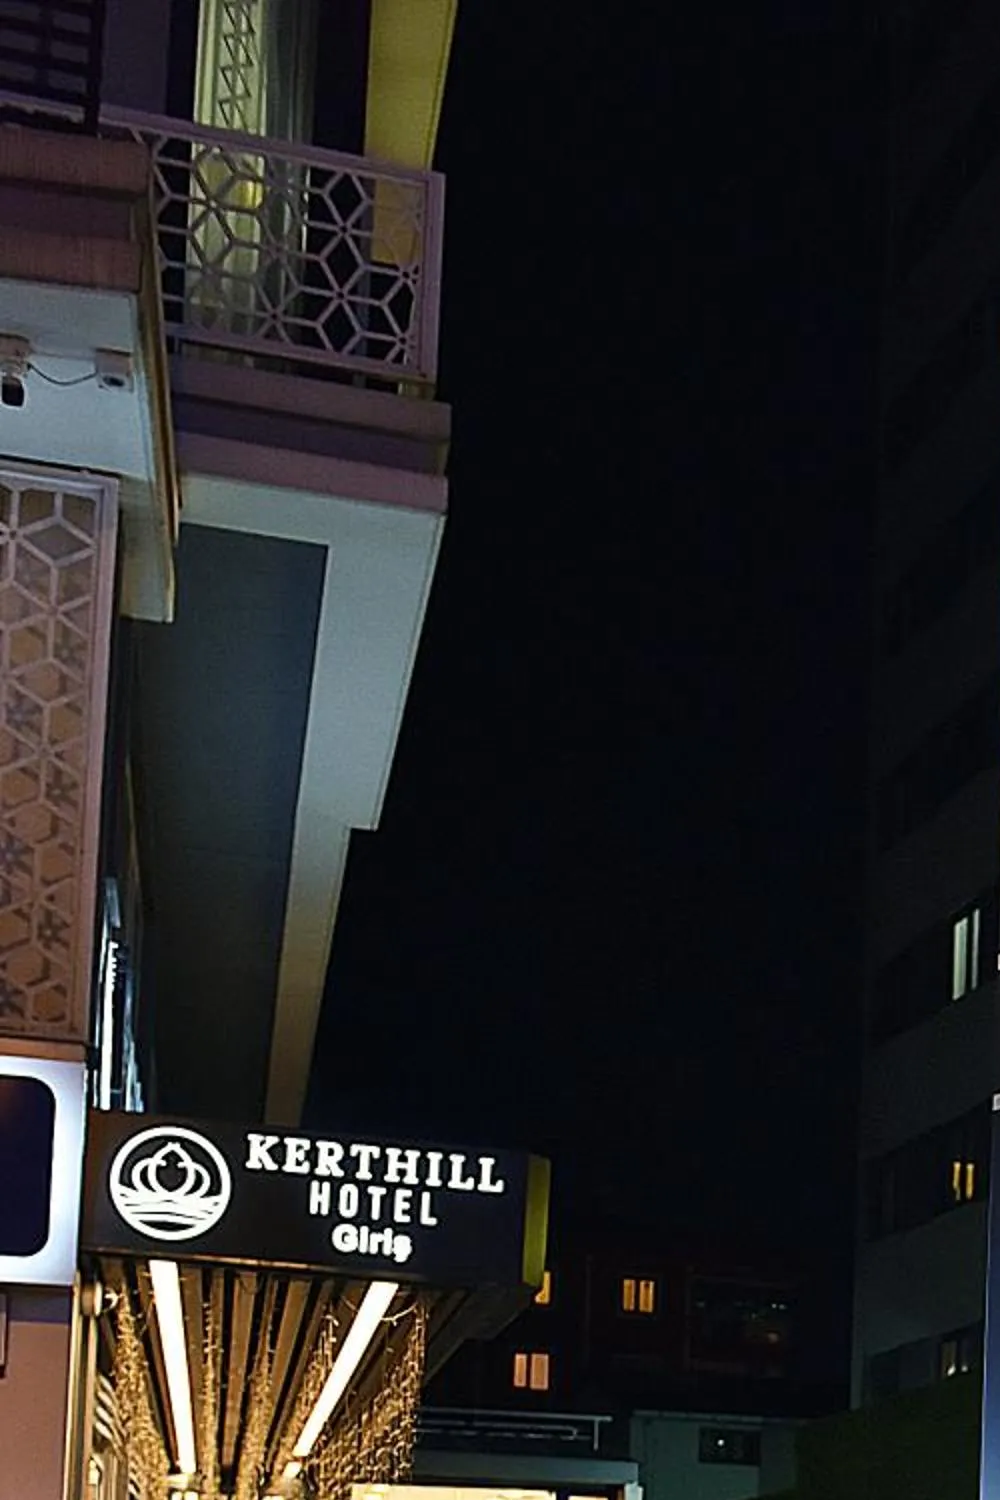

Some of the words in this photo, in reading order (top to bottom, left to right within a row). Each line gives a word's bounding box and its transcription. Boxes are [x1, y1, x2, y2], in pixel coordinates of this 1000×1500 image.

[245, 1133, 505, 1193] KERTHILL
[309, 1180, 438, 1226] HOTEL
[331, 1223, 413, 1263] Giriş
